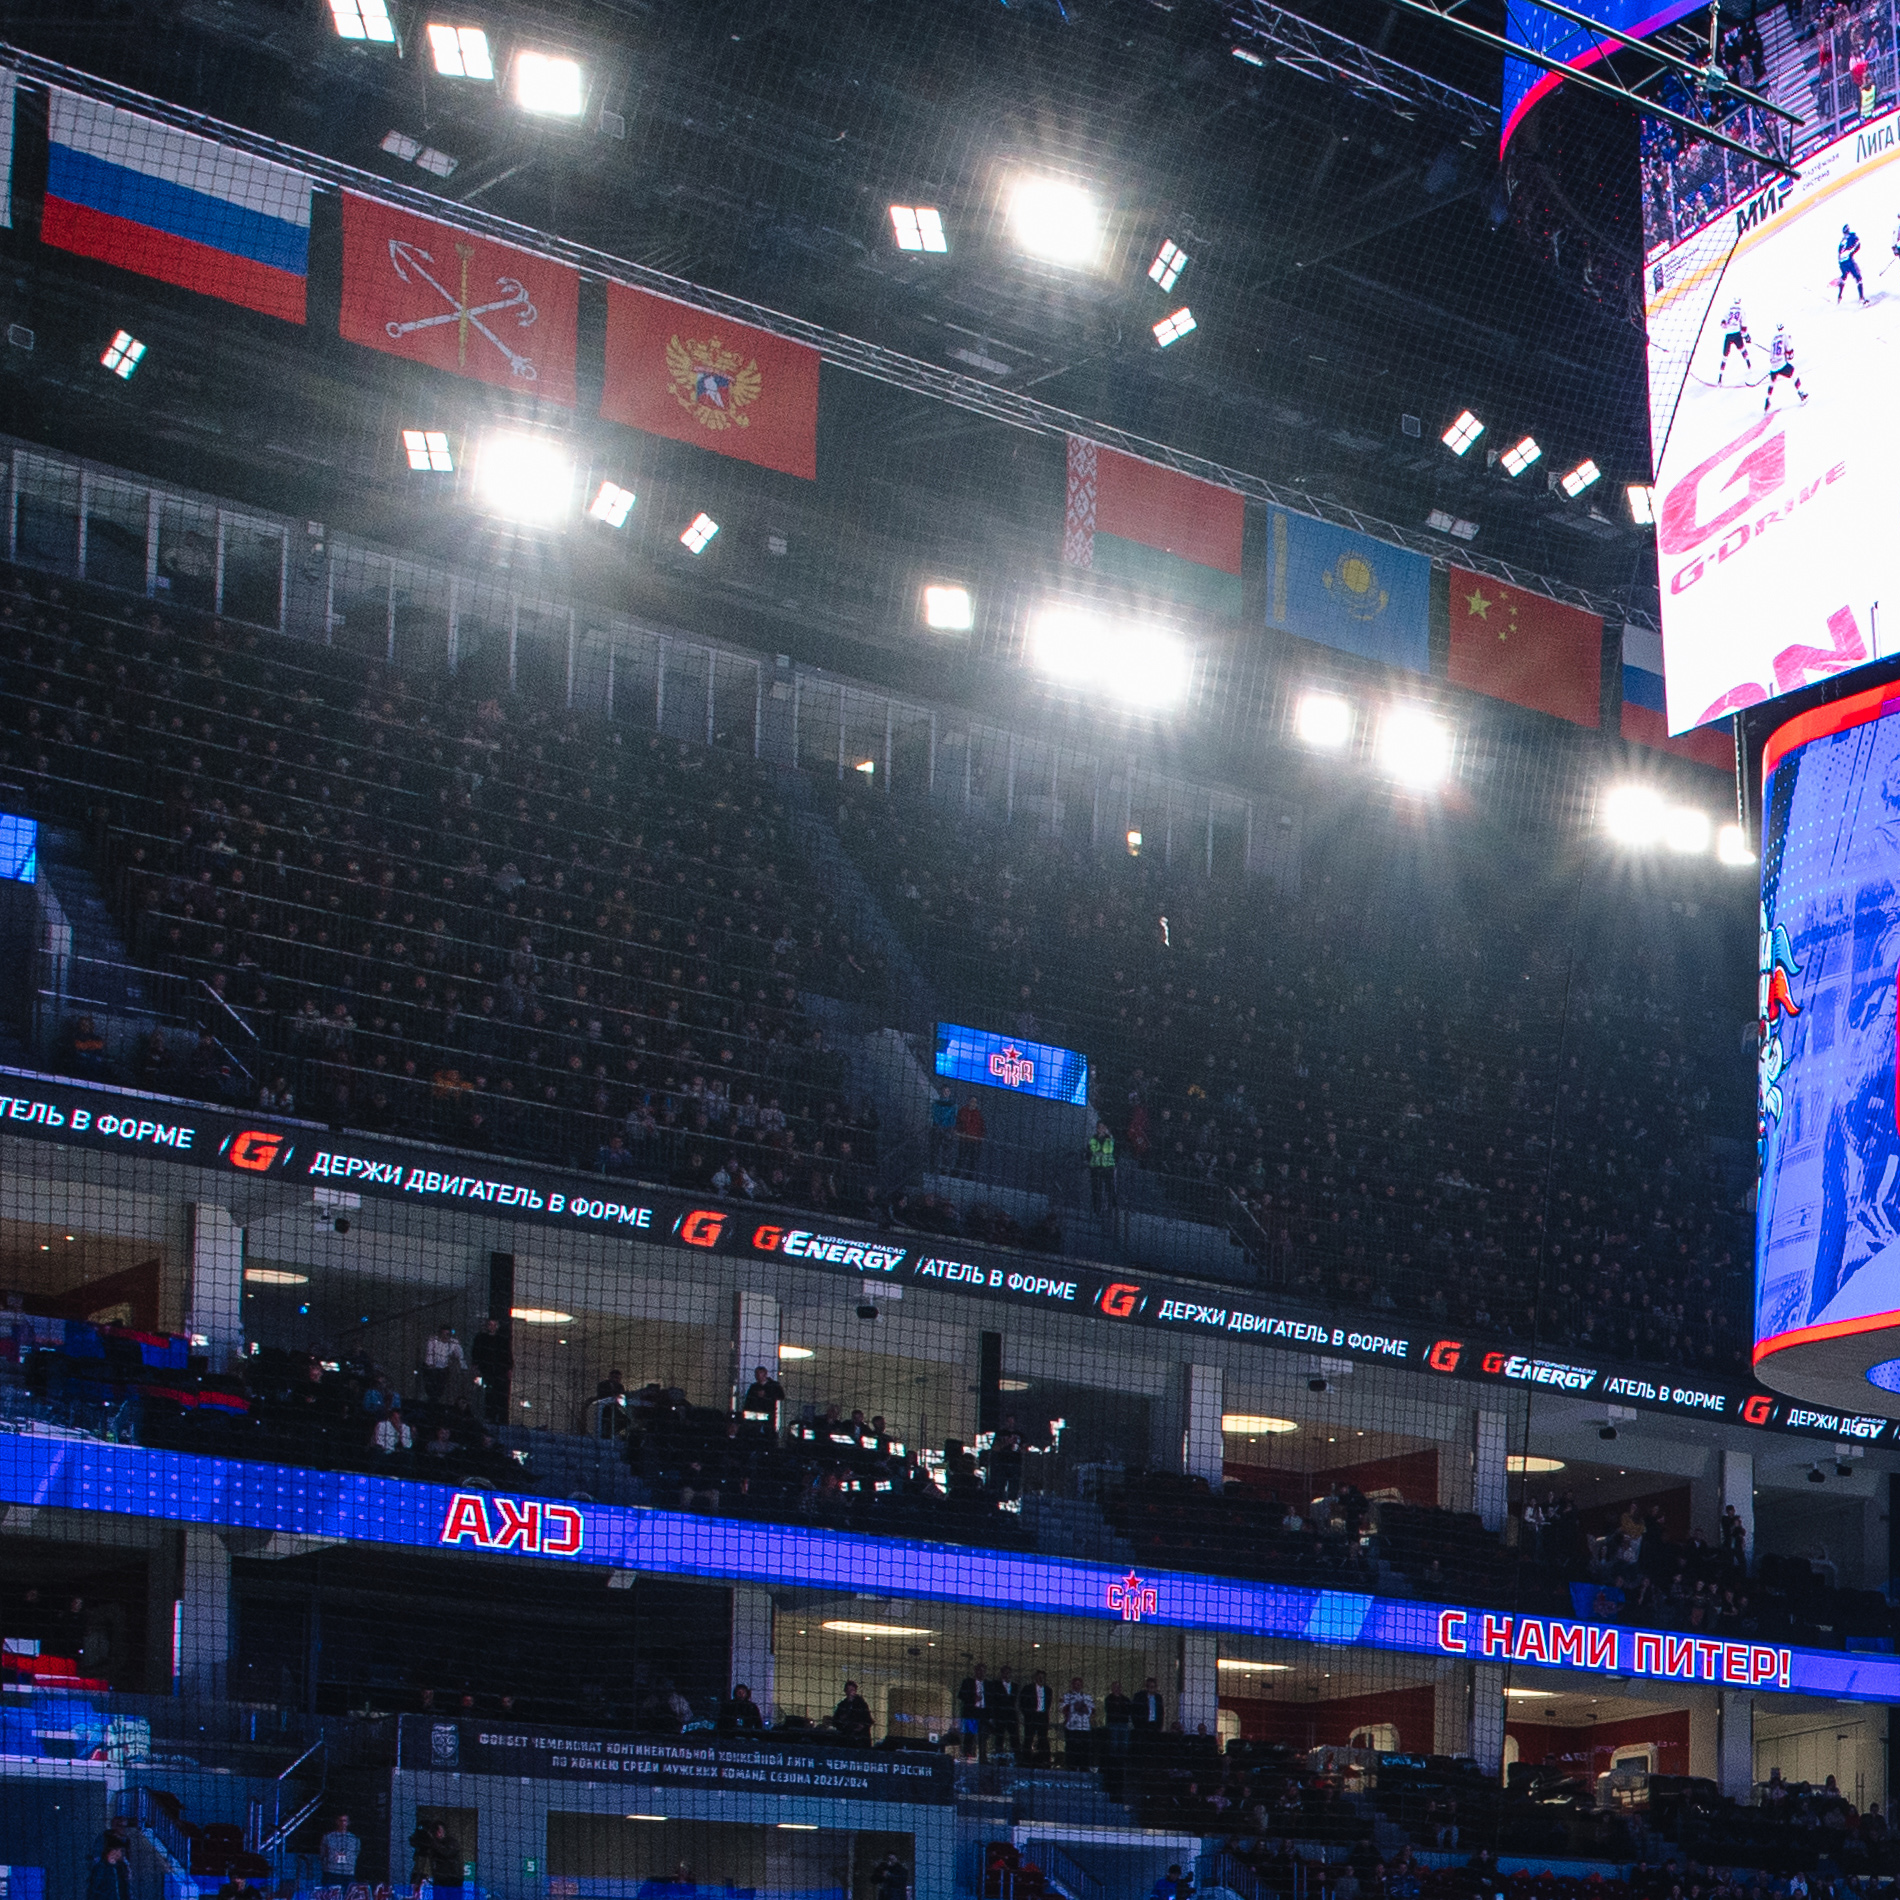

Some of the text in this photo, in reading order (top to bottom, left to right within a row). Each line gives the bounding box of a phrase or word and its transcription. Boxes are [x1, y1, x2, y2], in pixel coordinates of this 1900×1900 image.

[71, 1109, 194, 1149] В ФОРМЕ
[309, 1151, 652, 1229] ДЕРЖИ ДВИГАТЕЛЬ В ФОРМЕ
[989, 1269, 1003, 1286] В
[1008, 1272, 1077, 1301] ФОРМЕ
[1158, 1299, 1409, 1358] ДЕРЖИ ДВИГАТЕЛЬ В ФОРМЕ
[1439, 1609, 1792, 1689] С НАМИ ПИТЕР!
